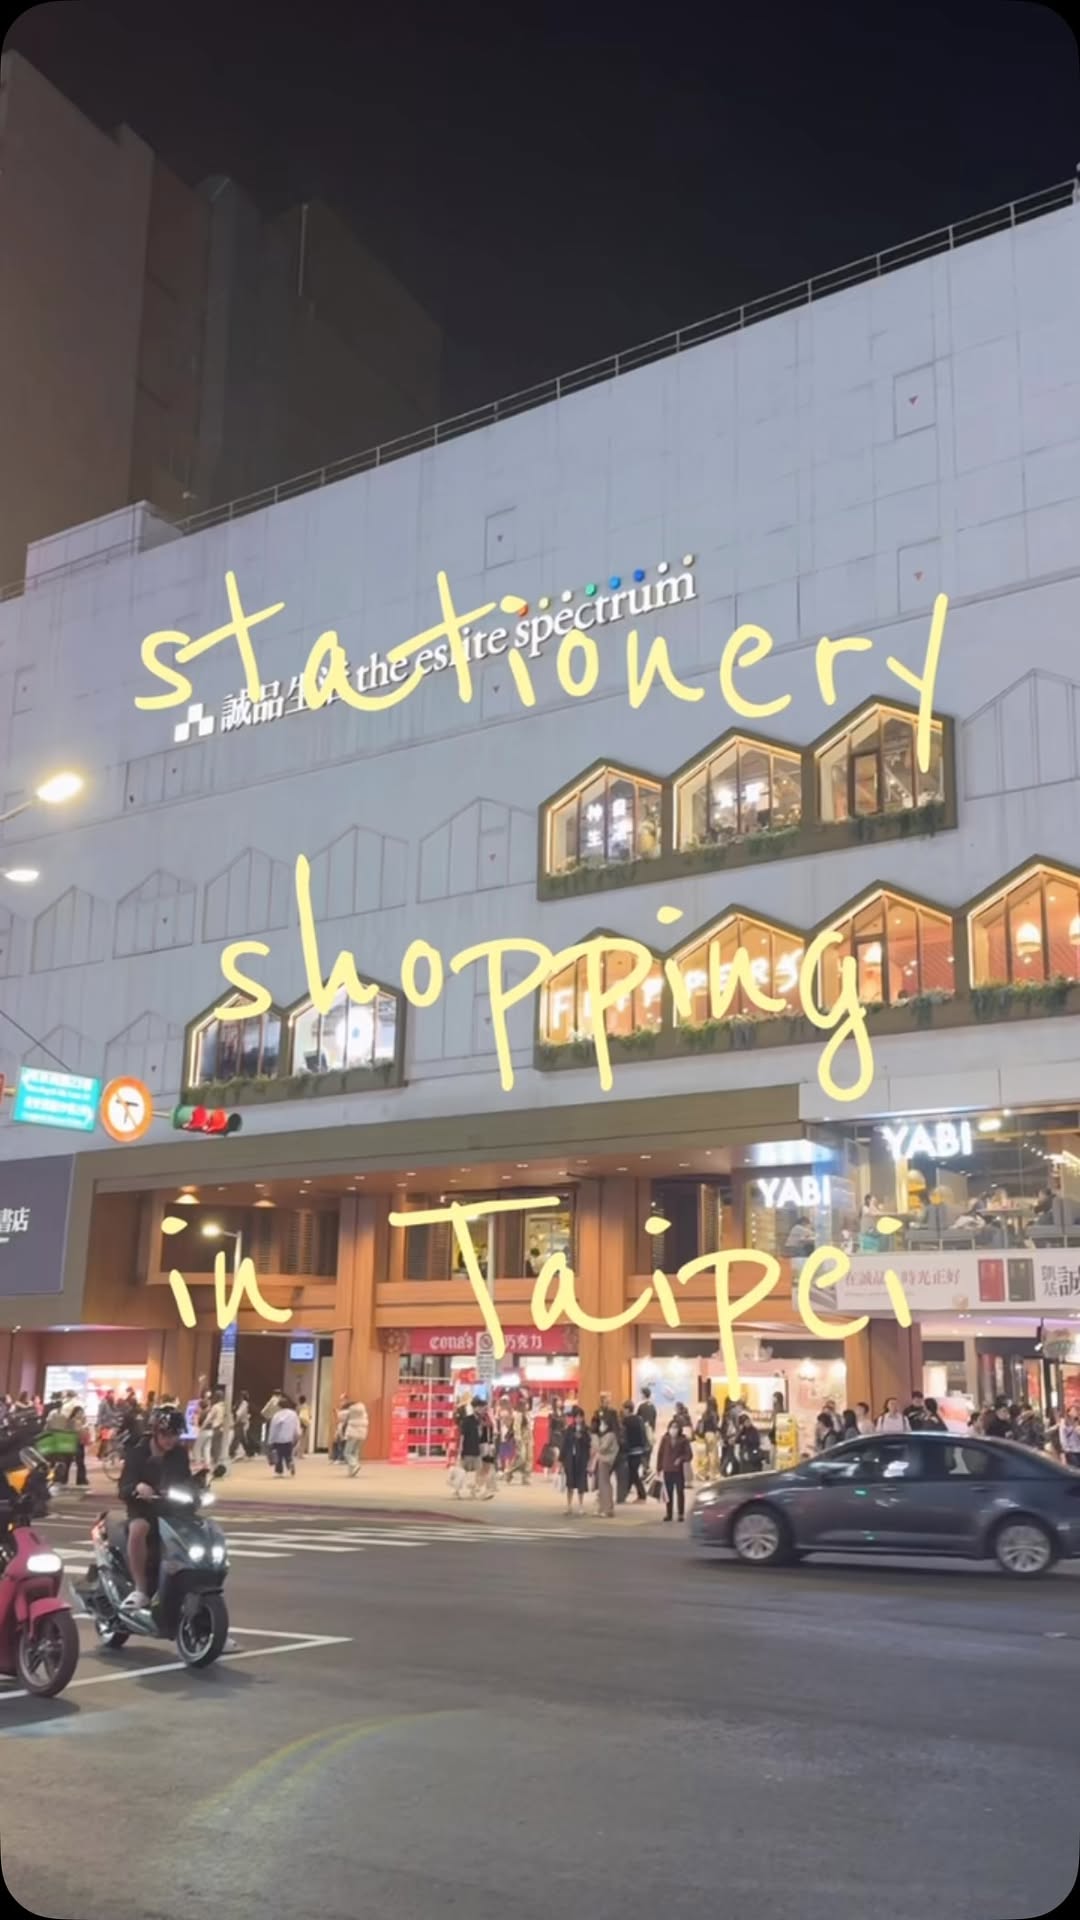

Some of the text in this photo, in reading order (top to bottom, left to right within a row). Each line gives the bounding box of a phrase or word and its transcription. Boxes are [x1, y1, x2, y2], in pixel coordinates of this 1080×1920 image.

[356, 652, 409, 692] the
[514, 571, 697, 658] spectrum
[881, 1120, 974, 1161] YABI
[757, 1174, 832, 1209] YABI
